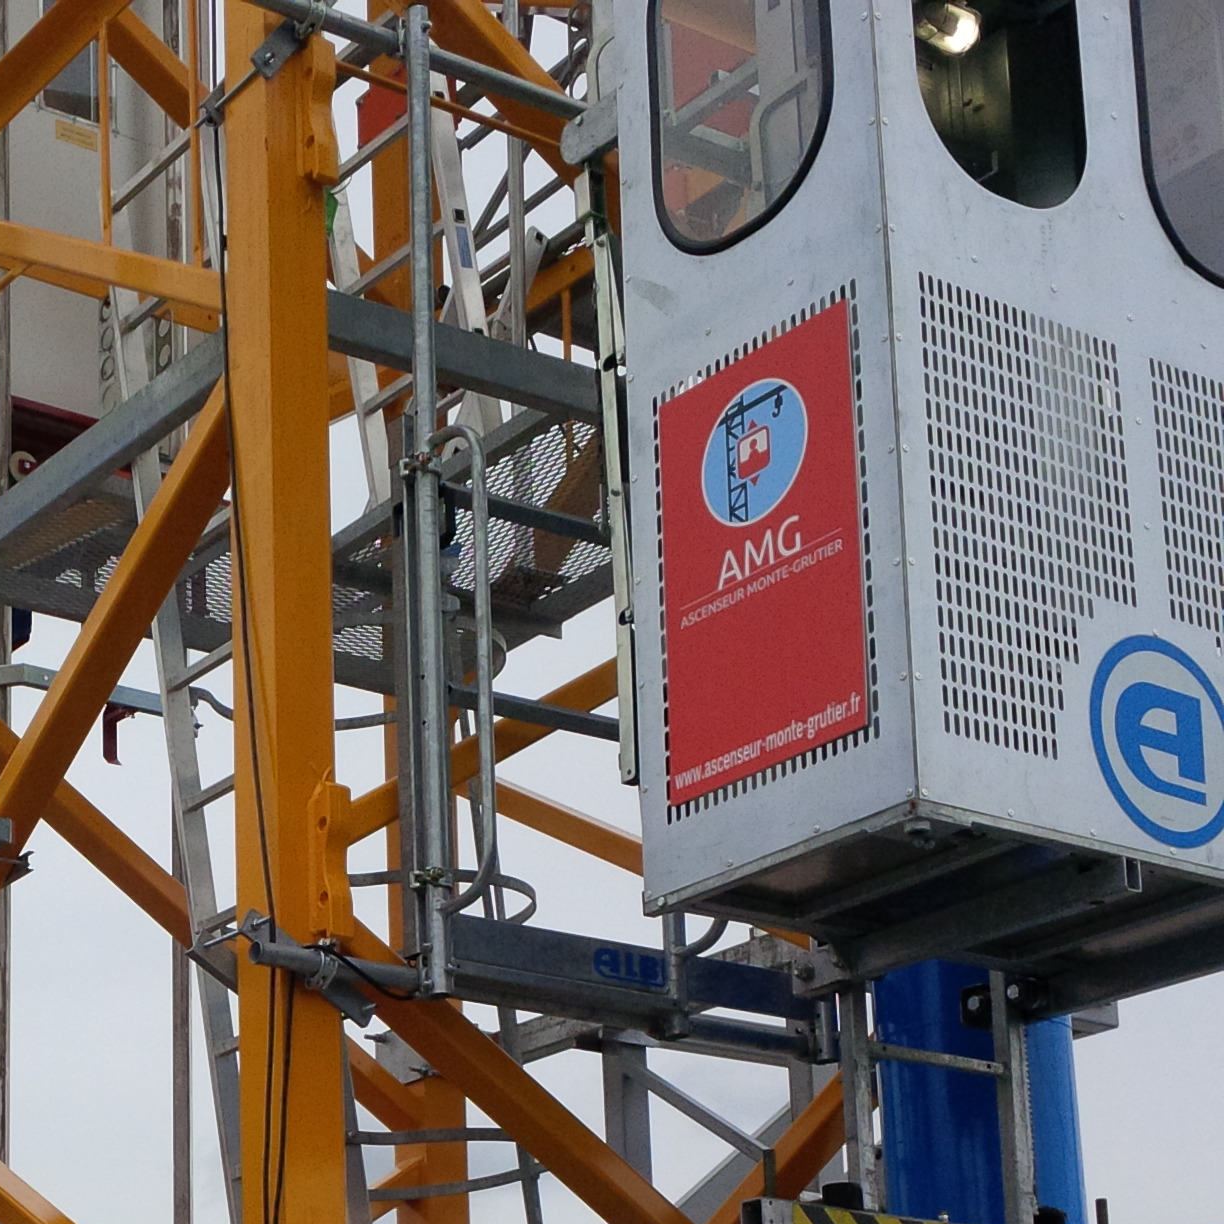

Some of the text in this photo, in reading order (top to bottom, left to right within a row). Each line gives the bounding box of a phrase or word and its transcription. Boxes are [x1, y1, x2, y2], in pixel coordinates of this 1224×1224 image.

[680, 538, 843, 630] ASCENSEUR MONTE-GRUTIER
[717, 514, 806, 592] AMG
[674, 692, 861, 790] www.ascenseur-monte-grutier.fr
